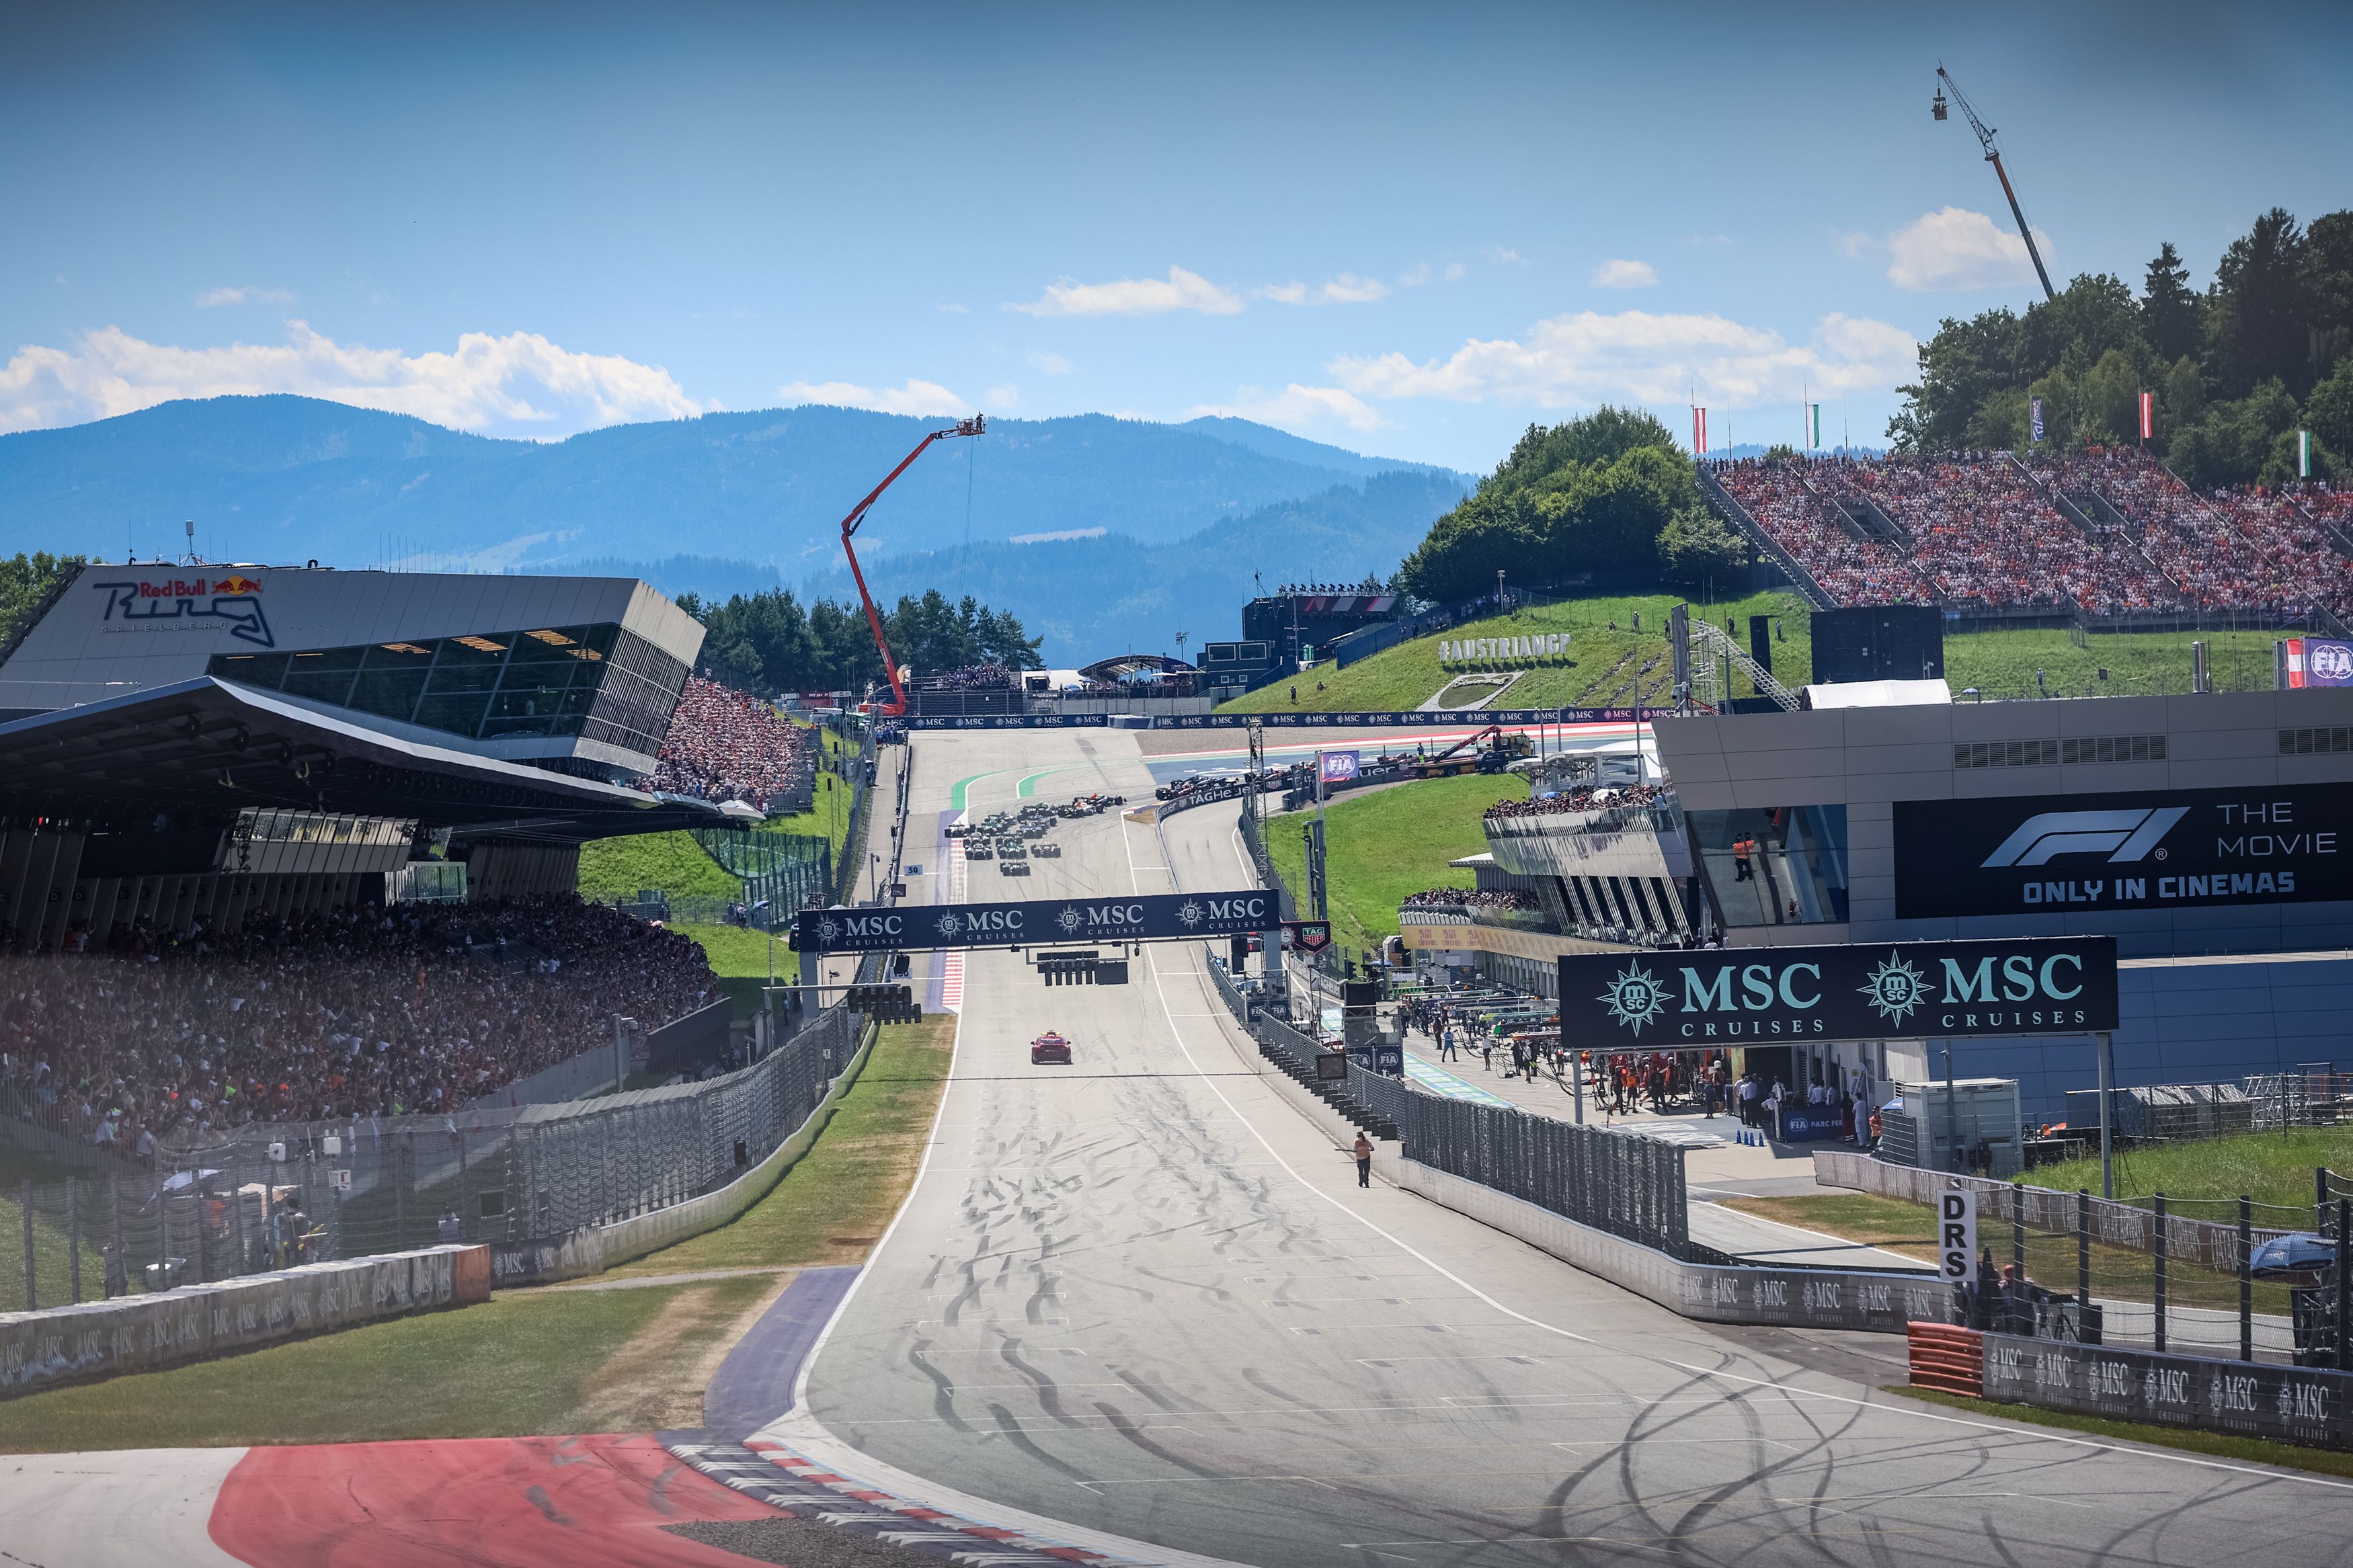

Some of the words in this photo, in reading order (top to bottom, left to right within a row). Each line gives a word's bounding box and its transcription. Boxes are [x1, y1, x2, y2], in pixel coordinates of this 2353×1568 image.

[141, 581, 172, 597] Red
[175, 579, 205, 596] Bull
[101, 622, 227, 633] SPIELBERG
[1438, 634, 1571, 661] #AUSTRIANGP
[1507, 712, 1523, 720] MSC
[1542, 712, 1558, 720] MSC
[1576, 710, 1593, 718] MSC
[1613, 710, 1631, 718] MSC
[1652, 710, 1671, 718] MSC
[2217, 802, 2292, 825] THE
[1979, 807, 2191, 868] F1
[2219, 832, 2337, 857] MOVIE
[2024, 880, 2103, 903] ONLY
[2115, 878, 2145, 900] IN
[2159, 871, 2295, 898] CINEMAS
[1087, 905, 1144, 925] MSC
[1208, 898, 1265, 919] MSC
[845, 916, 902, 937] MSC
[966, 910, 1023, 931] MSC
[1088, 926, 1144, 935] CRUISES
[1209, 920, 1265, 930] CRUISES
[846, 938, 903, 946] CRUISES
[967, 932, 1024, 940] CRUISES
[1305, 935, 1323, 945] HEUER
[1679, 962, 1821, 1013] MSC
[1940, 954, 2083, 1003] MSC
[1681, 1019, 1823, 1036] CRUISES
[1942, 1010, 2084, 1028] CRUISES
[1944, 1195, 1967, 1277] DRS
[504, 1252, 526, 1274] MSC
[1718, 1277, 1739, 1304] MSC
[1764, 1280, 1788, 1307] MSC
[1816, 1282, 1841, 1309] MSC
[1868, 1284, 1892, 1311] MSC
[46, 1335, 65, 1365] MSC
[83, 1330, 104, 1359] MSC
[6, 1342, 26, 1373] MSC
[1999, 1348, 2022, 1380] MSC
[2047, 1353, 2071, 1389] MSC
[2102, 1361, 2128, 1397] MSC
[2159, 1368, 2189, 1405] MSC
[2225, 1375, 2258, 1411] MSC
[2296, 1383, 2329, 1421] MSC
[2225, 1418, 2258, 1431] CRUISES
[2295, 1426, 2329, 1440] CRUISES
